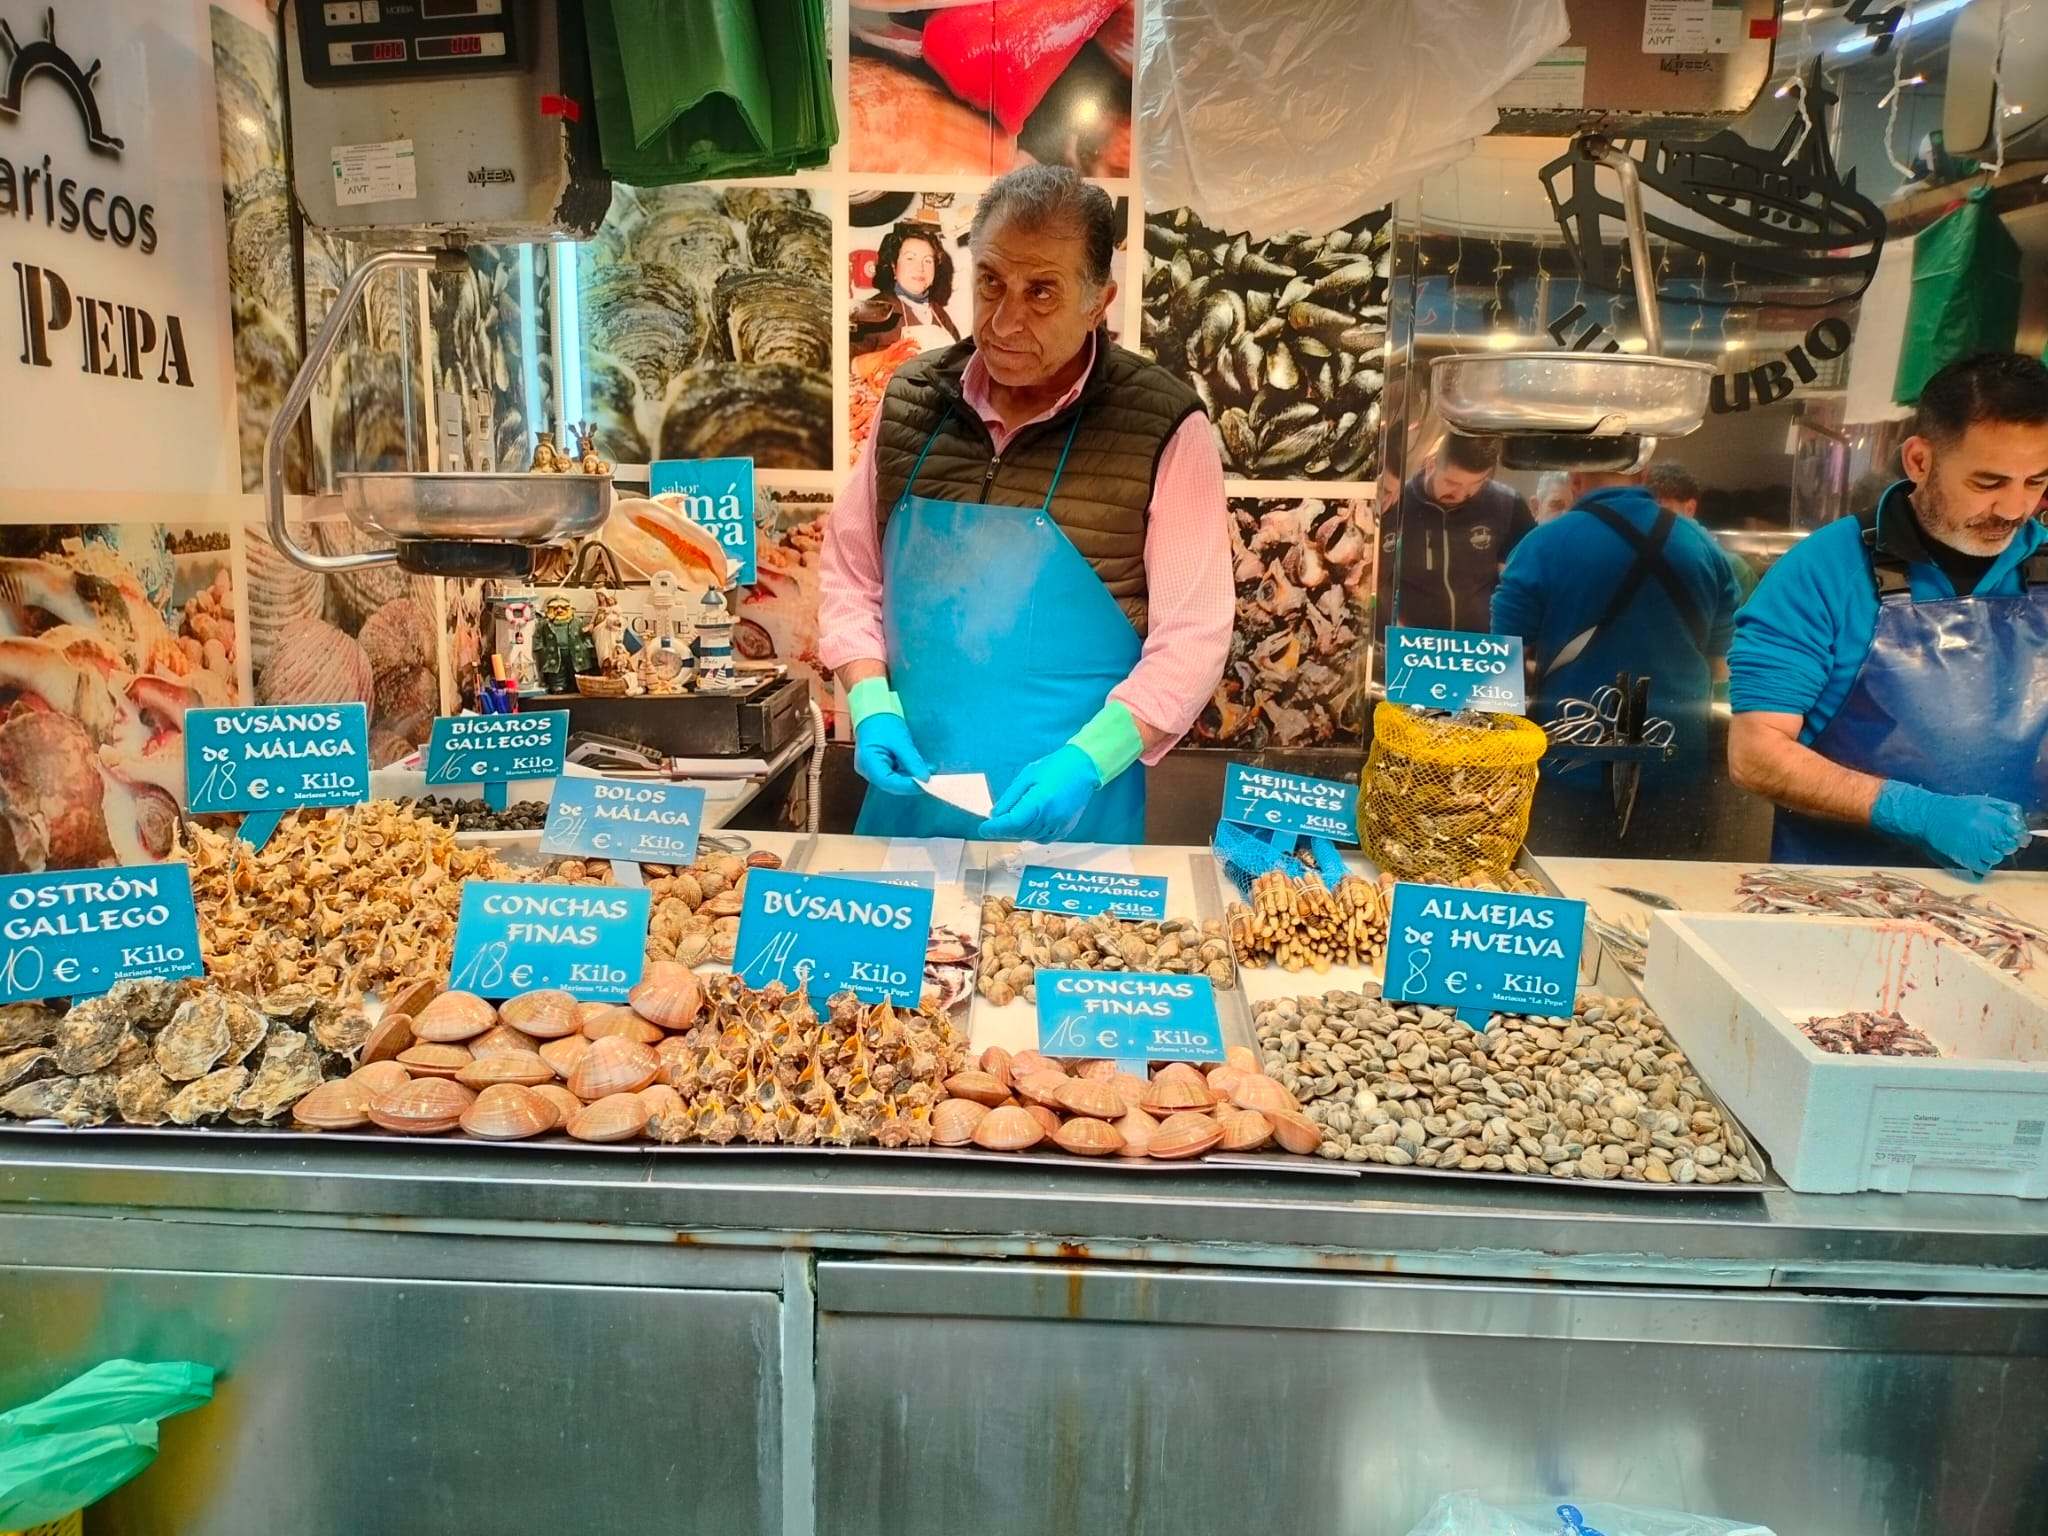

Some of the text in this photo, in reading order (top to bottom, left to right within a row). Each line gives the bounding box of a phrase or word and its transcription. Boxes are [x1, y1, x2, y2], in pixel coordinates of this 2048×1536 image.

[0, 154, 157, 254] ariscos
[12, 261, 194, 387] PEPA
[1709, 317, 1851, 413] UBIO
[661, 481, 700, 494] sabor
[1400, 634, 1510, 657] MEJILLÓN
[1403, 653, 1506, 674] GALLEGO
[1388, 667, 1413, 698] 4
[1471, 684, 1513, 700] Kilo
[451, 717, 552, 735] BÍGAROS
[202, 737, 356, 762] de MÁLAGA
[445, 733, 552, 751] GALLEGOS
[429, 753, 467, 783] 16
[513, 756, 553, 769] Kilo
[192, 761, 355, 806] 18 € Kilo
[594, 784, 667, 804] BOLOS
[1239, 770, 1346, 799] MEJILLÓN
[1242, 784, 1343, 811] FRANCÉS
[559, 803, 691, 827] de MÁLAGA
[1235, 796, 1258, 820] 7
[1306, 814, 1347, 830] Kilo
[548, 816, 684, 850] 24 € Kilo
[9, 876, 159, 910] OSTRÓN
[1050, 871, 1141, 887] ALMEJAS
[1057, 883, 1160, 898] CANTÁBRICO
[483, 894, 628, 920] CONCHAS
[763, 888, 912, 930] BÚSANOS
[1019, 890, 1050, 906] 18
[1108, 902, 1154, 912] Kilo
[1420, 898, 1555, 930] ALMEJAS
[3, 905, 170, 940] GALLEGO
[507, 922, 598, 945] FINAS
[1404, 926, 1565, 959] de HUELVA
[0, 944, 185, 995] 10 € Kilo
[451, 940, 627, 989] 18 € Kilo
[740, 931, 798, 980] 14
[851, 961, 907, 985] Kilo
[1403, 948, 1560, 996] 8 € Kilo
[1057, 978, 1194, 998] CONCHAS
[1084, 998, 1171, 1017] FINAS
[1043, 1015, 1208, 1049] 16 € Kilo
